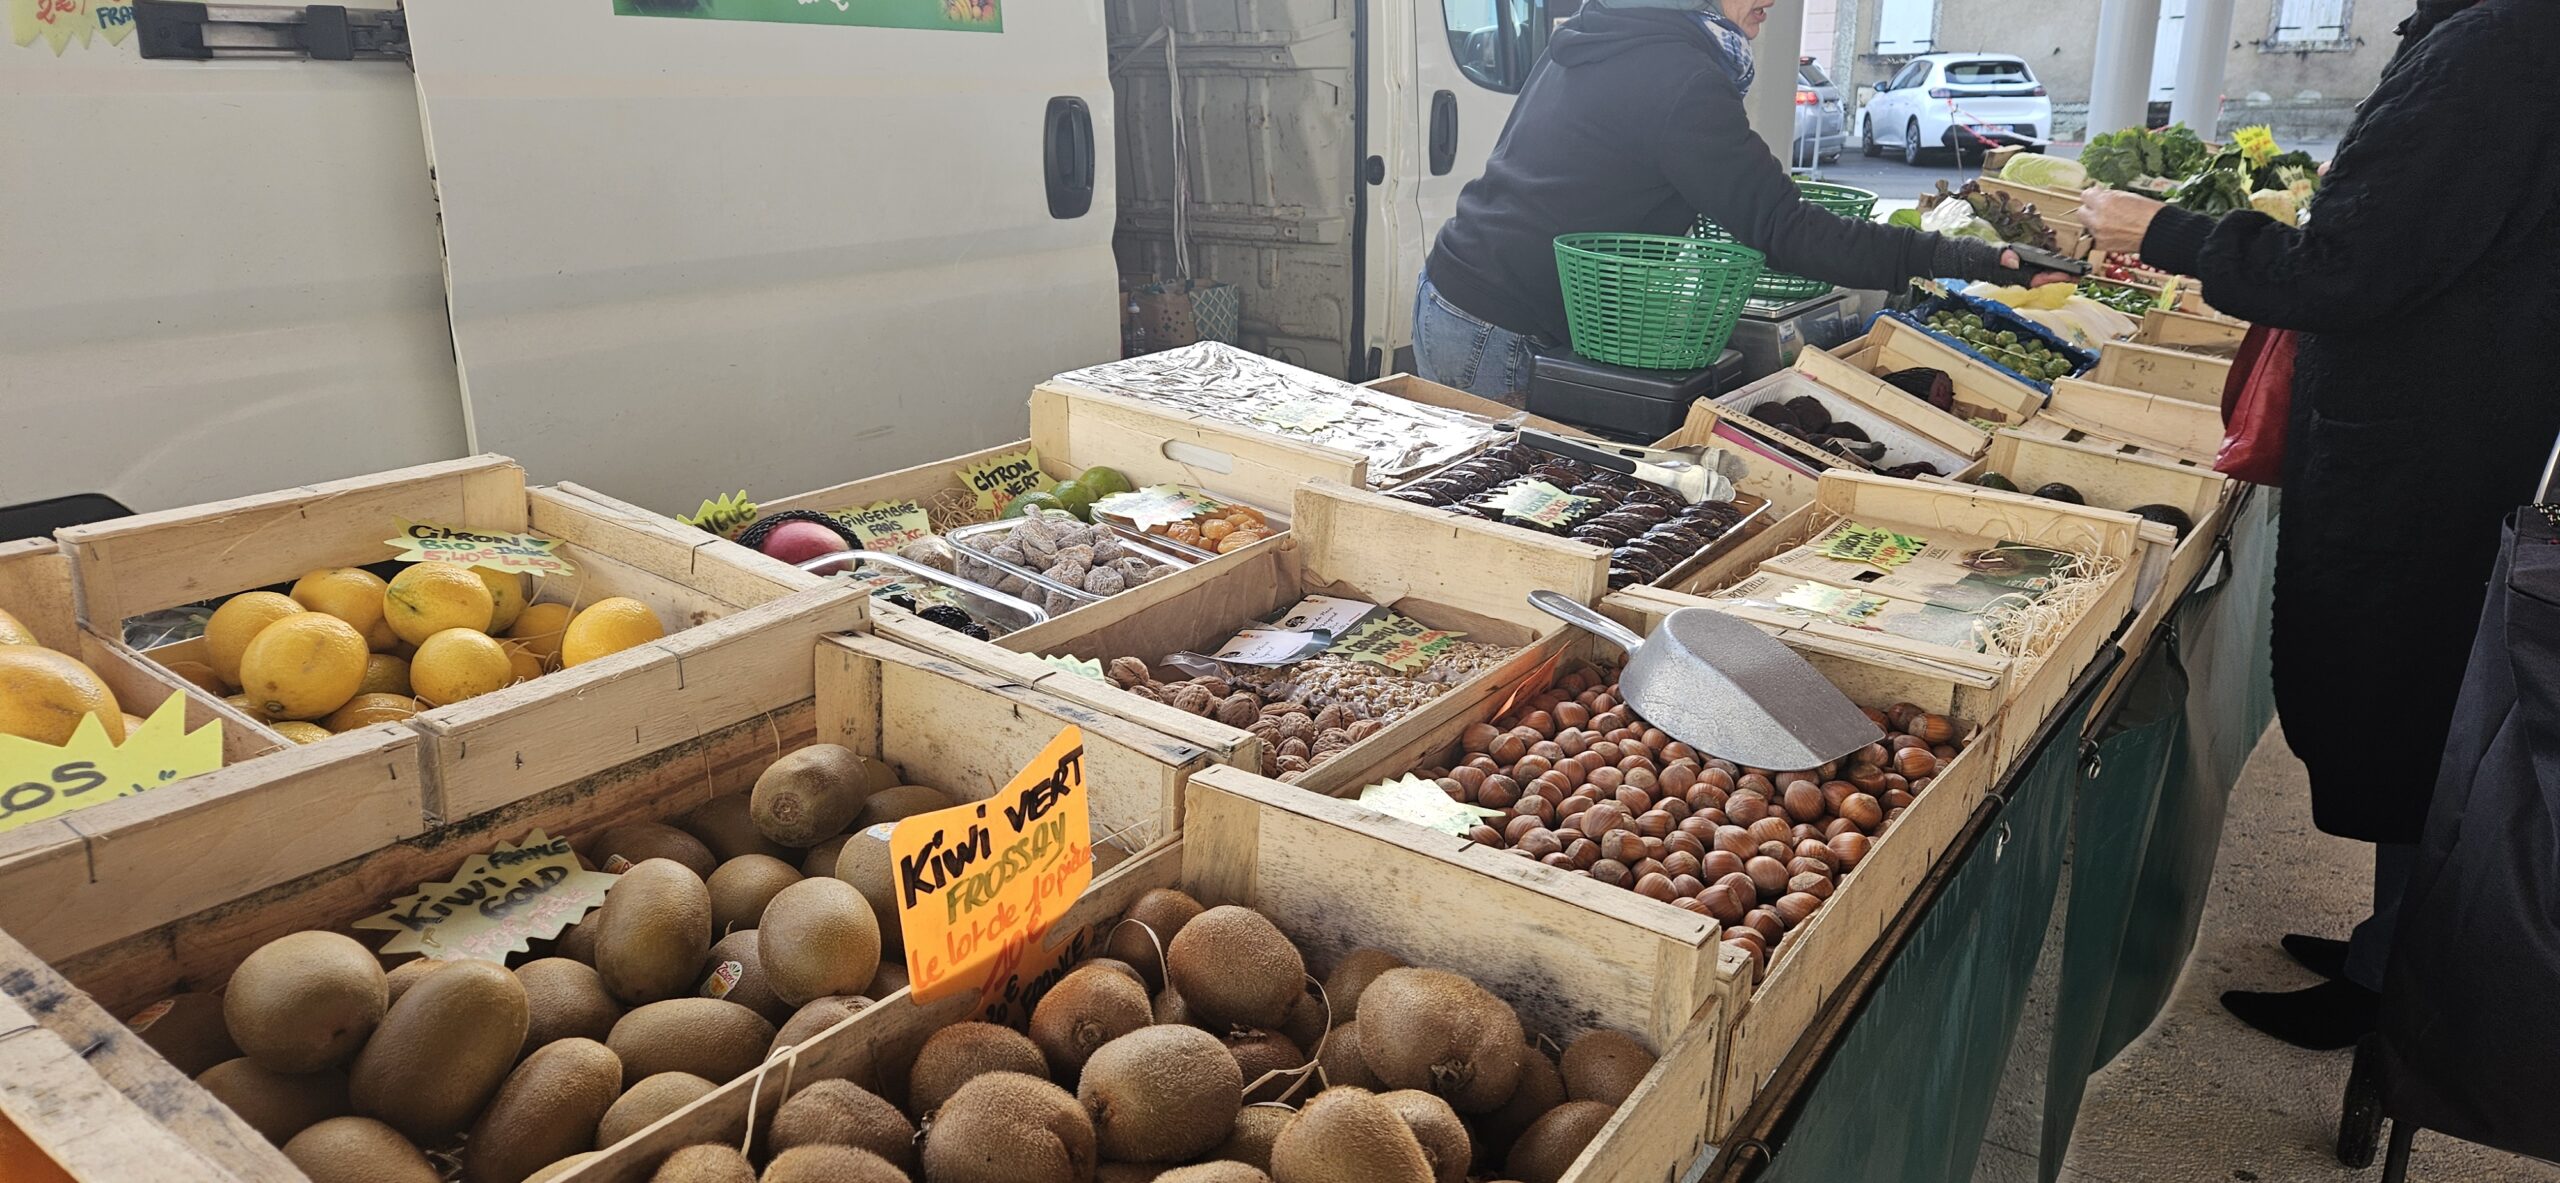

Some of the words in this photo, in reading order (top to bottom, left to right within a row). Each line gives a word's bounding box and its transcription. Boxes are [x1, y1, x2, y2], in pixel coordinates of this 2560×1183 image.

[0, 761, 107, 819] OS
[1004, 744, 1084, 833] VERT
[946, 812, 1066, 925] FROSSAY
[987, 902, 1019, 945] de
